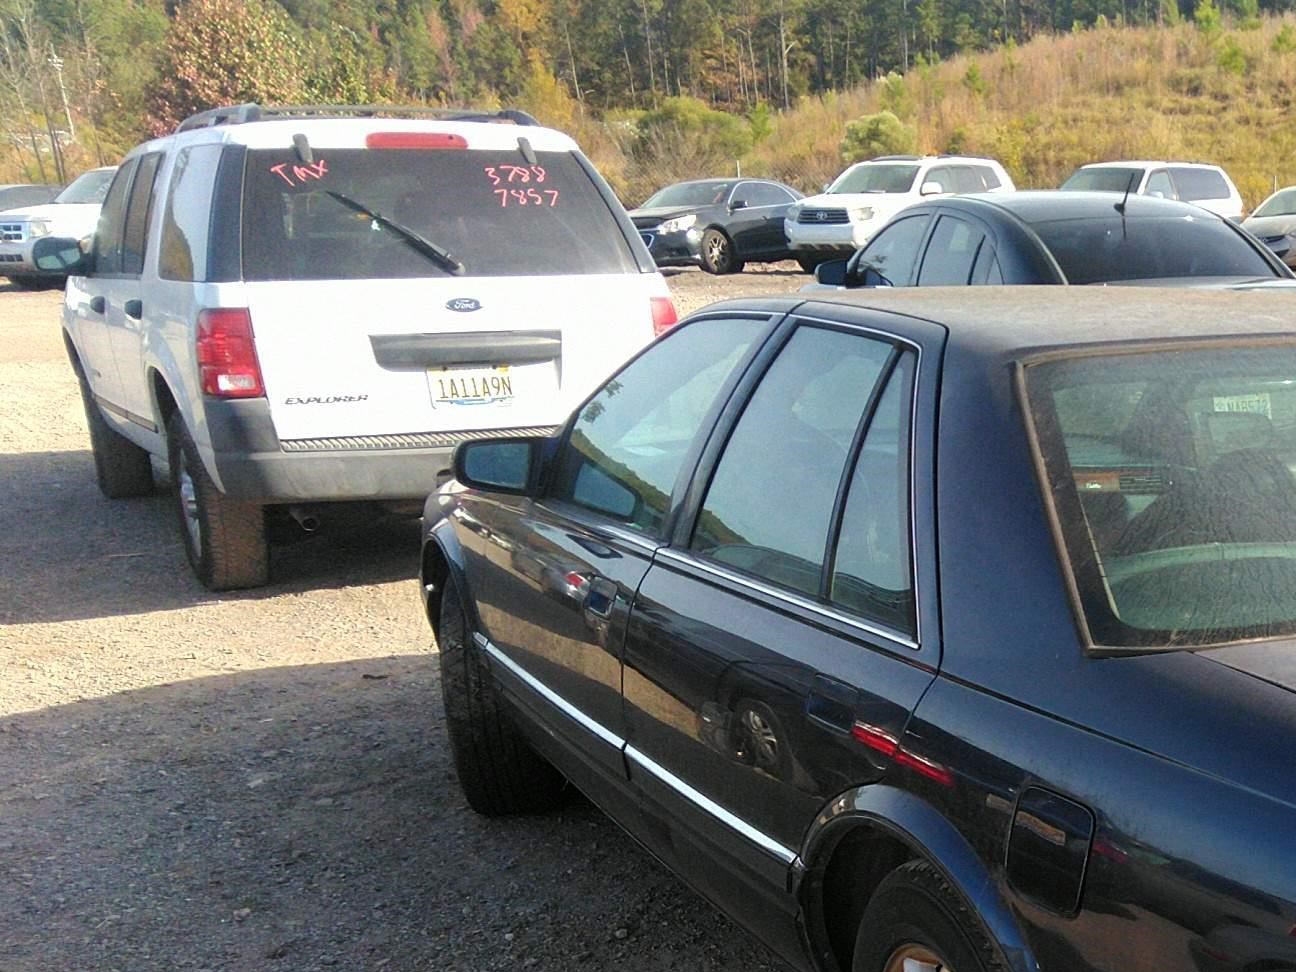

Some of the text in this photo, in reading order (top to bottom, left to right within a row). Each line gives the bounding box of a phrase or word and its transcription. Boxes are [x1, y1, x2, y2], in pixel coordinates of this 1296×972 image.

[485, 165, 546, 185] 3788
[494, 188, 559, 208] 7857
[450, 299, 477, 311] Ford
[439, 376, 513, 398] 1A11A9N
[284, 394, 369, 405] EXPLORER
